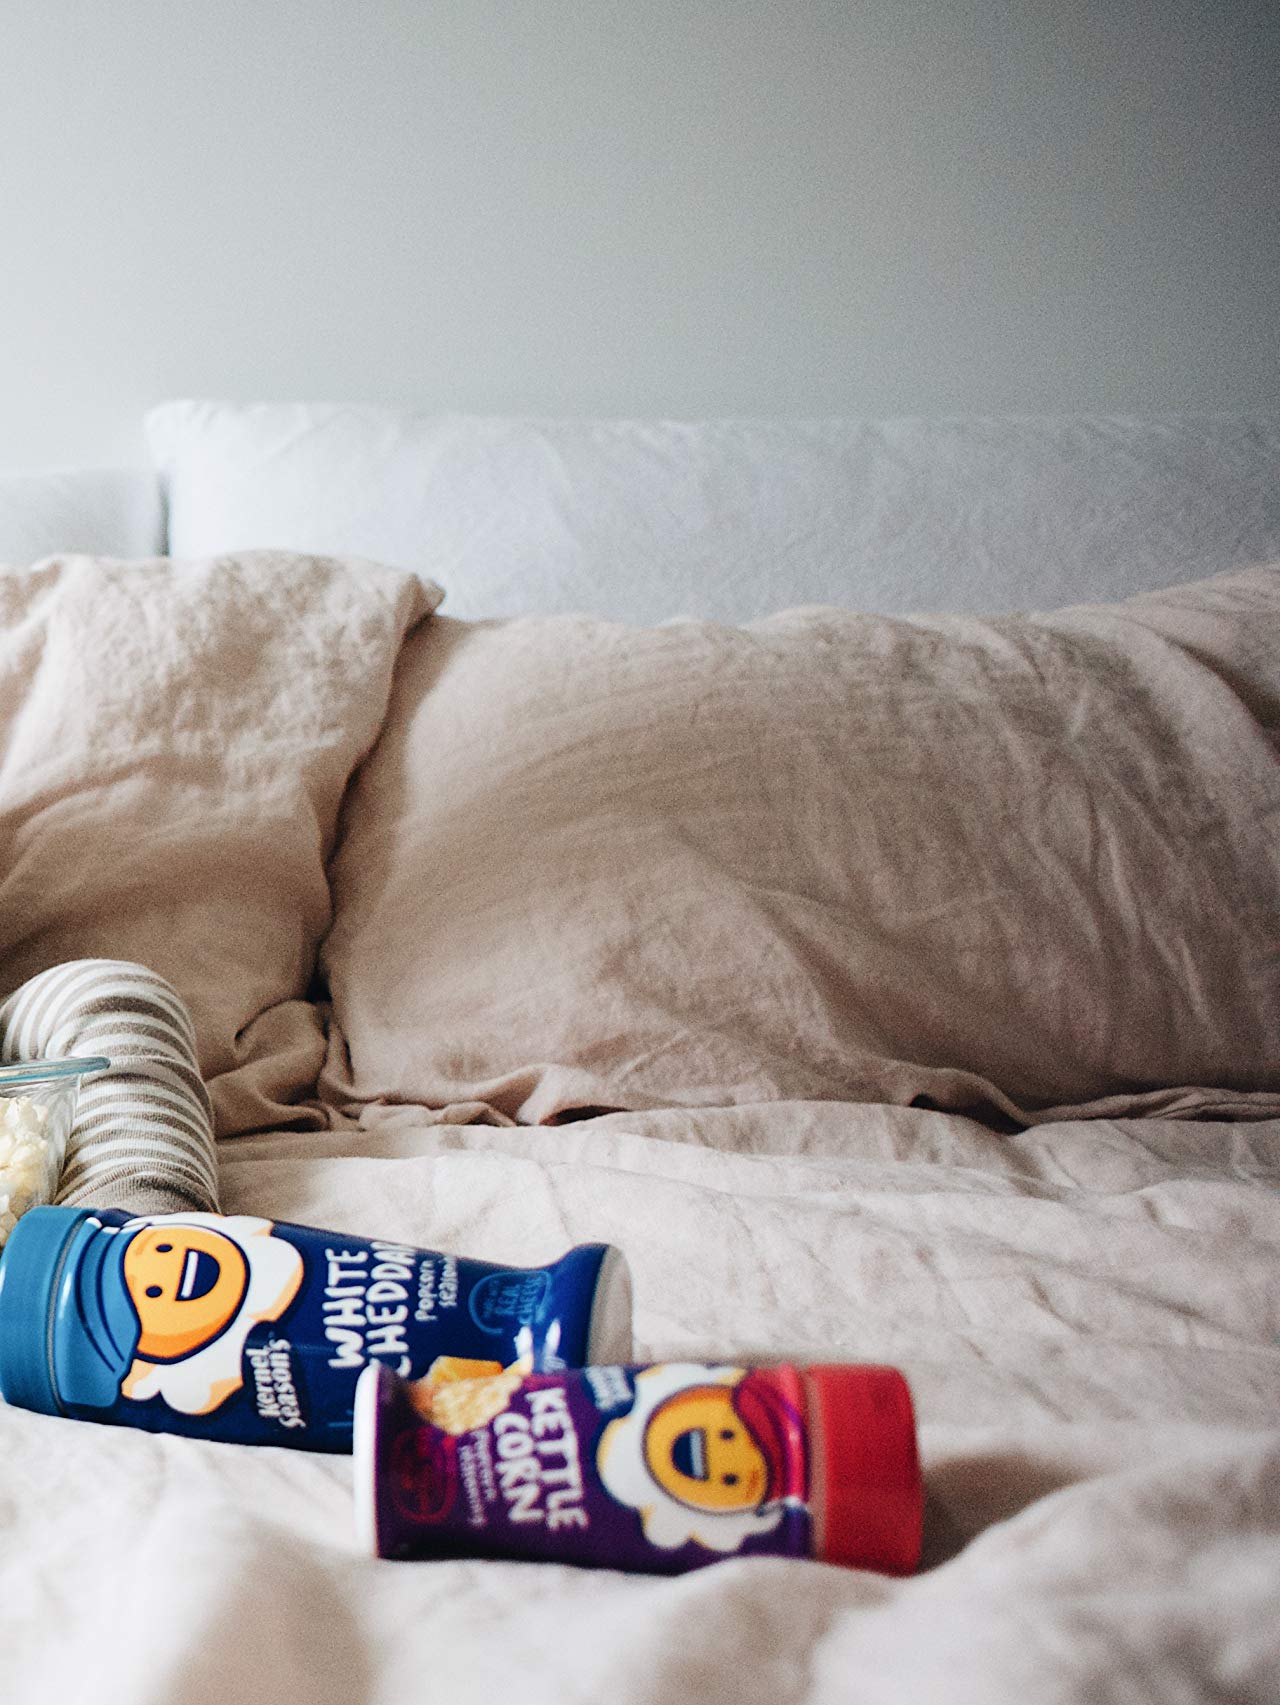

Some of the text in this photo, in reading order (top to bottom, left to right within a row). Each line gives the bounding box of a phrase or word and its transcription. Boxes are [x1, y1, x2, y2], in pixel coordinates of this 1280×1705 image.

[322, 1248, 369, 1368] WHITE
[493, 1412, 546, 1523] CORN
[524, 1387, 590, 1530] KETTLE
